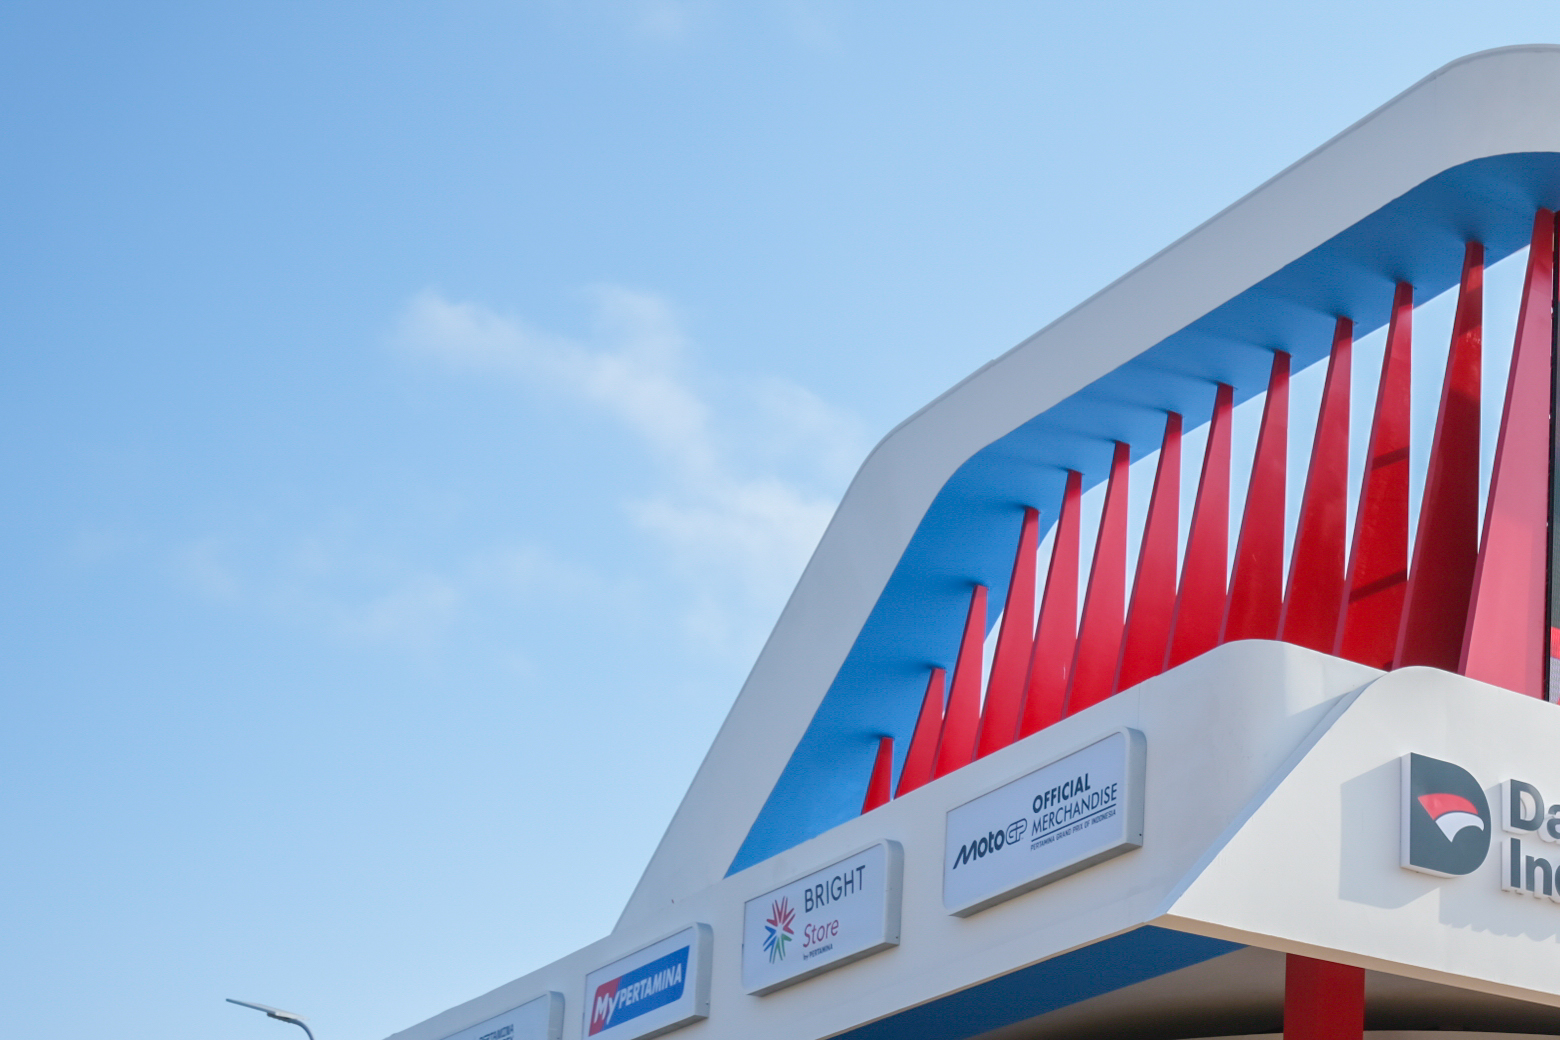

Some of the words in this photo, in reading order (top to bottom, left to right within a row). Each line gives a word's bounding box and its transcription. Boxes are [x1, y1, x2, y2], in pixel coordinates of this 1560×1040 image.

[1031, 782, 1118, 837] MERCHANDISE
[1032, 773, 1091, 814] OFFICIAL
[952, 817, 1028, 870] MotoGP
[1030, 836, 1055, 852] PERTAMINA
[1055, 829, 1072, 843] GRAND
[1072, 824, 1084, 834] PRIX
[1084, 821, 1091, 829] OF
[1091, 809, 1117, 827] INDONESIA
[804, 864, 866, 914] BRIGHT
[802, 919, 839, 948] Store
[809, 943, 834, 959] PERTAMINA
[593, 963, 682, 1026] MyPERTAMINA
